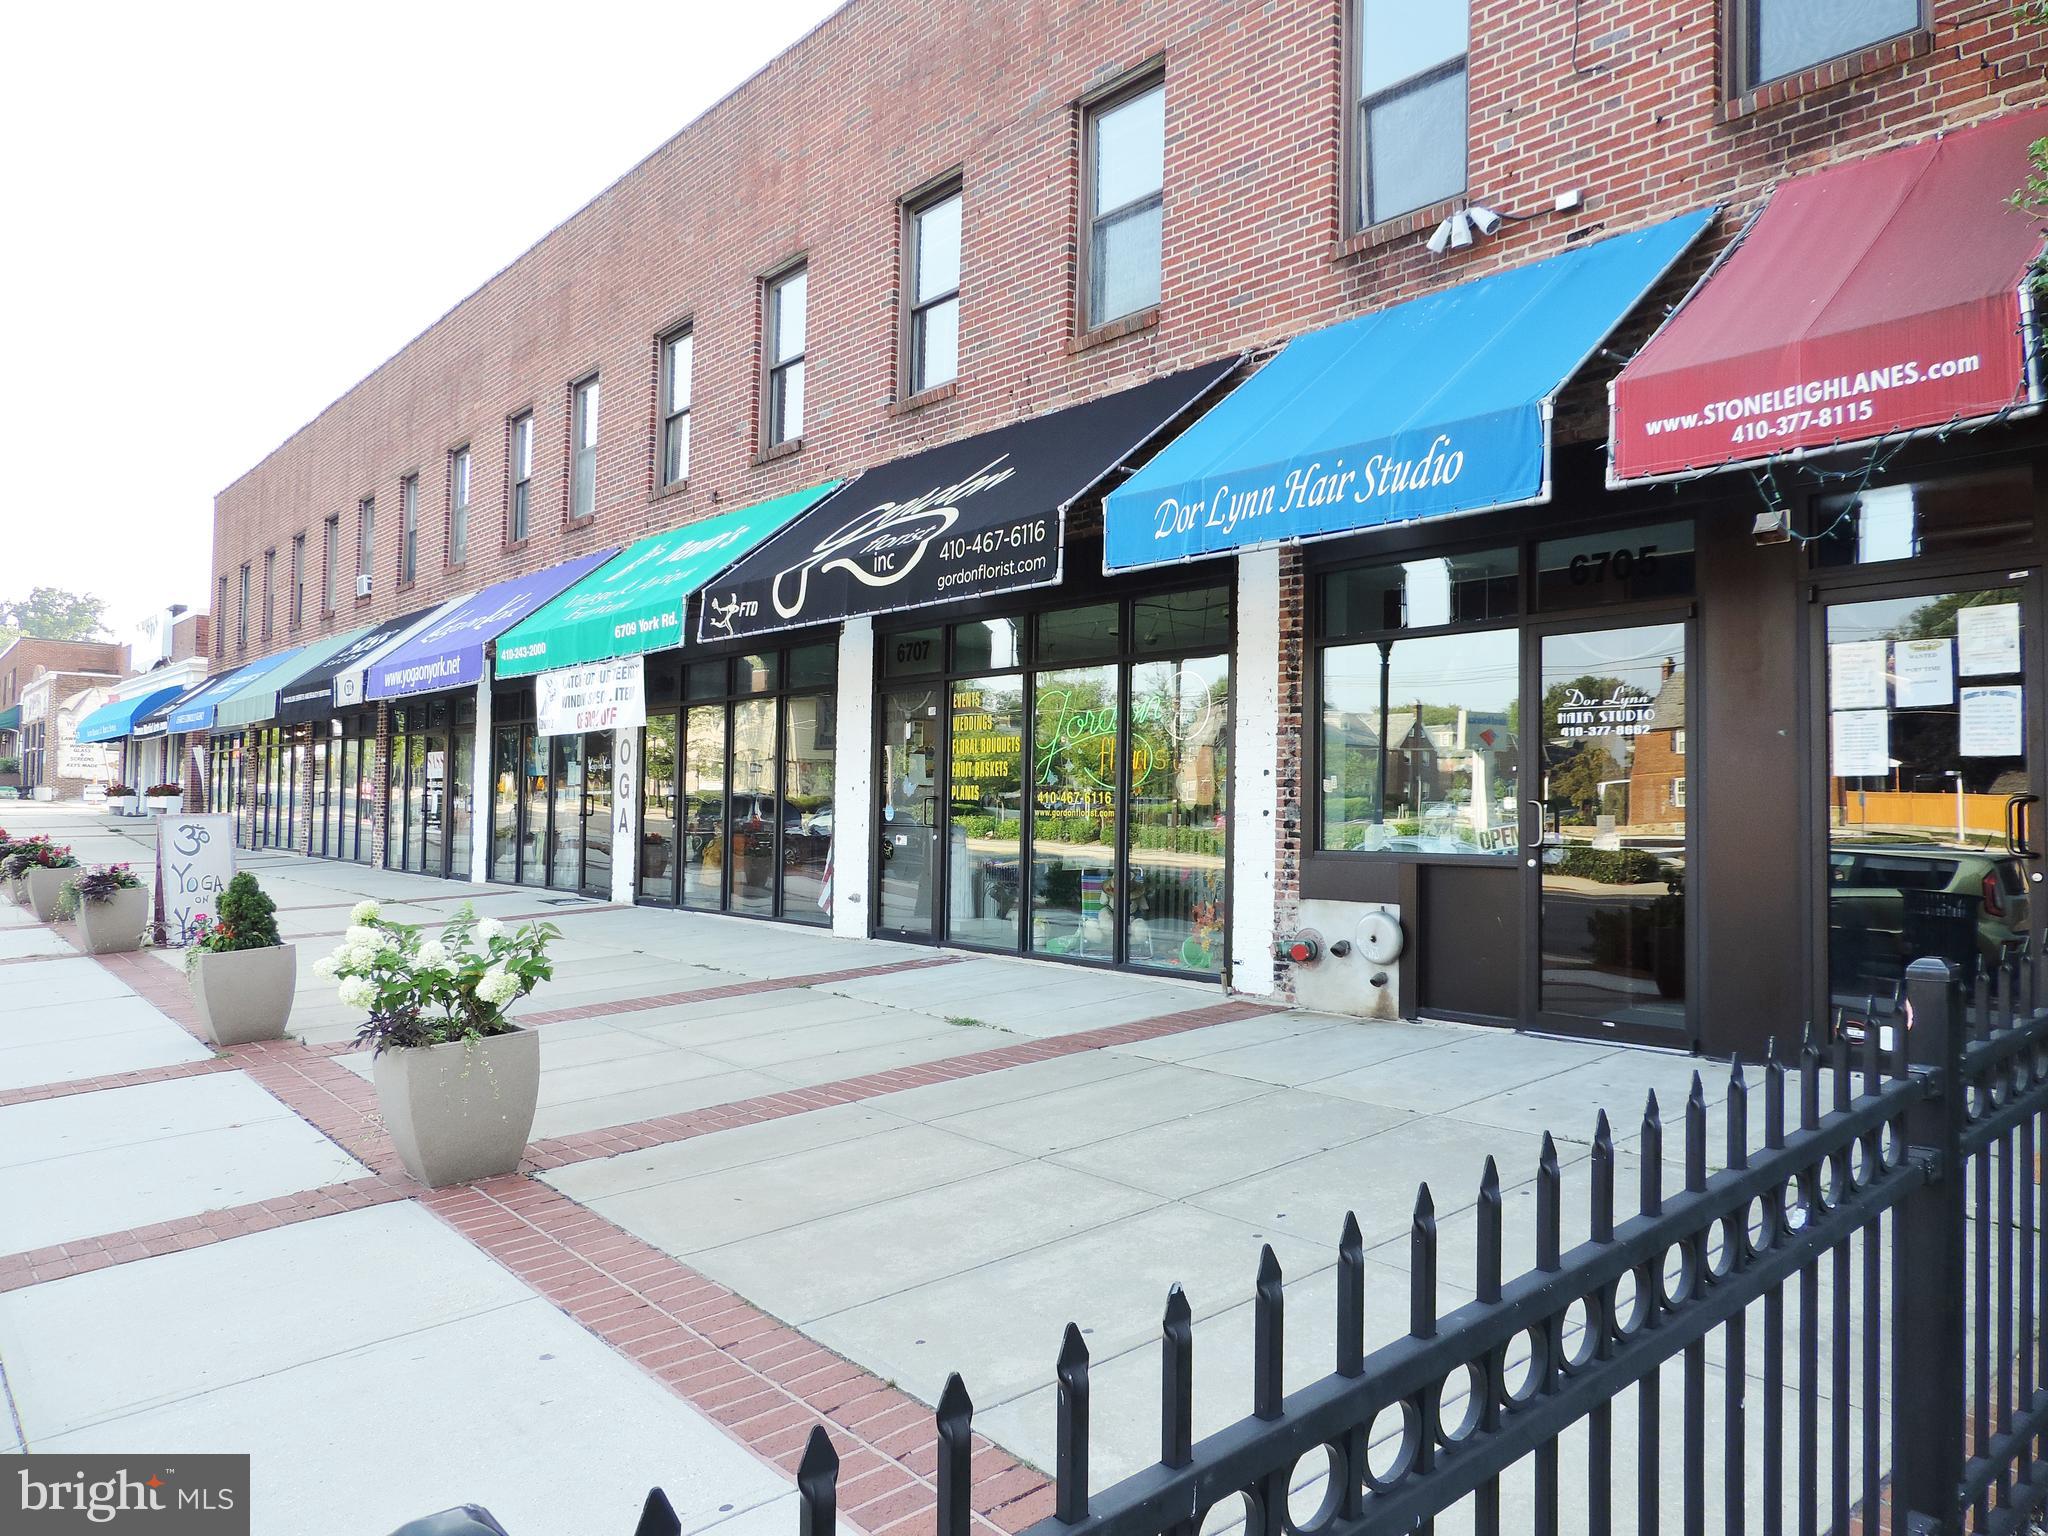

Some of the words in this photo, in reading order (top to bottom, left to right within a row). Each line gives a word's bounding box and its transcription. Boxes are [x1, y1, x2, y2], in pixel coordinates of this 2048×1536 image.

[1645, 354, 1981, 436] www.STONELEIGHLANES.com
[1731, 399, 1873, 443] 410-377-8115
[1154, 498, 1205, 540] Dor
[1205, 485, 1276, 535] Lynn
[1279, 462, 1355, 513] Hair
[1354, 434, 1464, 504] Studio
[939, 519, 1046, 561] 410-467-6116
[873, 552, 895, 573] inc
[937, 555, 1046, 591] gordonflorist.com
[1569, 545, 1658, 585] 6705
[738, 600, 759, 617] FTD
[614, 622, 637, 639] 6709
[639, 617, 659, 636] York
[661, 612, 679, 629] Rd.
[501, 642, 546, 661] 410-243-2000
[896, 640, 931, 663] 6707
[384, 655, 461, 689] www.yogaonyork.net
[953, 692, 981, 709] EVENTS
[1563, 689, 1599, 708] Dor
[1603, 686, 1648, 710] Lynn
[952, 714, 992, 731] WEDDINGS
[1557, 711, 1595, 725] HAIR
[1600, 709, 1656, 723] STUDIO
[1560, 724, 1651, 737] 410-377-8662
[952, 737, 978, 754] FLORAL
[981, 736, 1021, 753] BOUQUETS
[951, 761, 973, 778] FRUIT
[975, 761, 1009, 777] BASKETS
[951, 784, 980, 801] PLANTS
[1037, 791, 1112, 804] 410-467-6116
[171, 863, 224, 894] YOGA
[195, 895, 210, 904] ON
